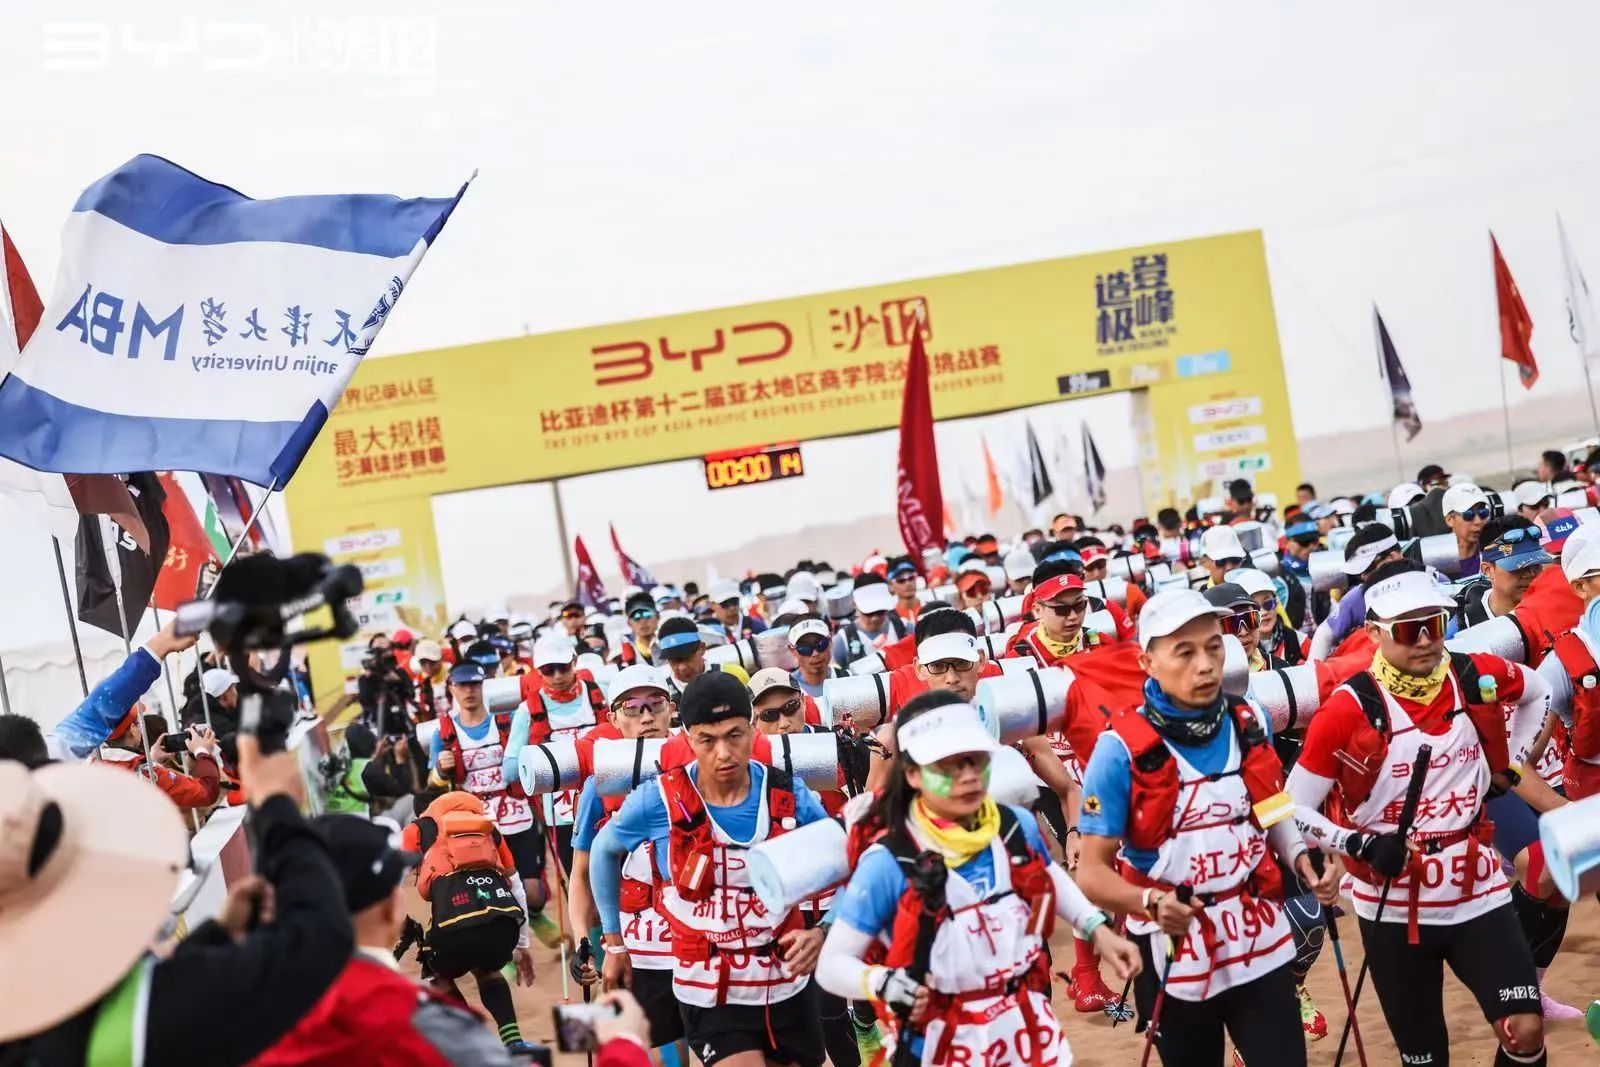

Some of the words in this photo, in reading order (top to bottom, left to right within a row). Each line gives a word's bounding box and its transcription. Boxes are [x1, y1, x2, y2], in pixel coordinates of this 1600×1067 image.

[591, 321, 793, 386] BYD
[540, 344, 1001, 433] 比亚迪杯第十二届亚太地区商学院沙挑战赛
[334, 416, 442, 456] 最大规模
[706, 453, 772, 488] 00:00
